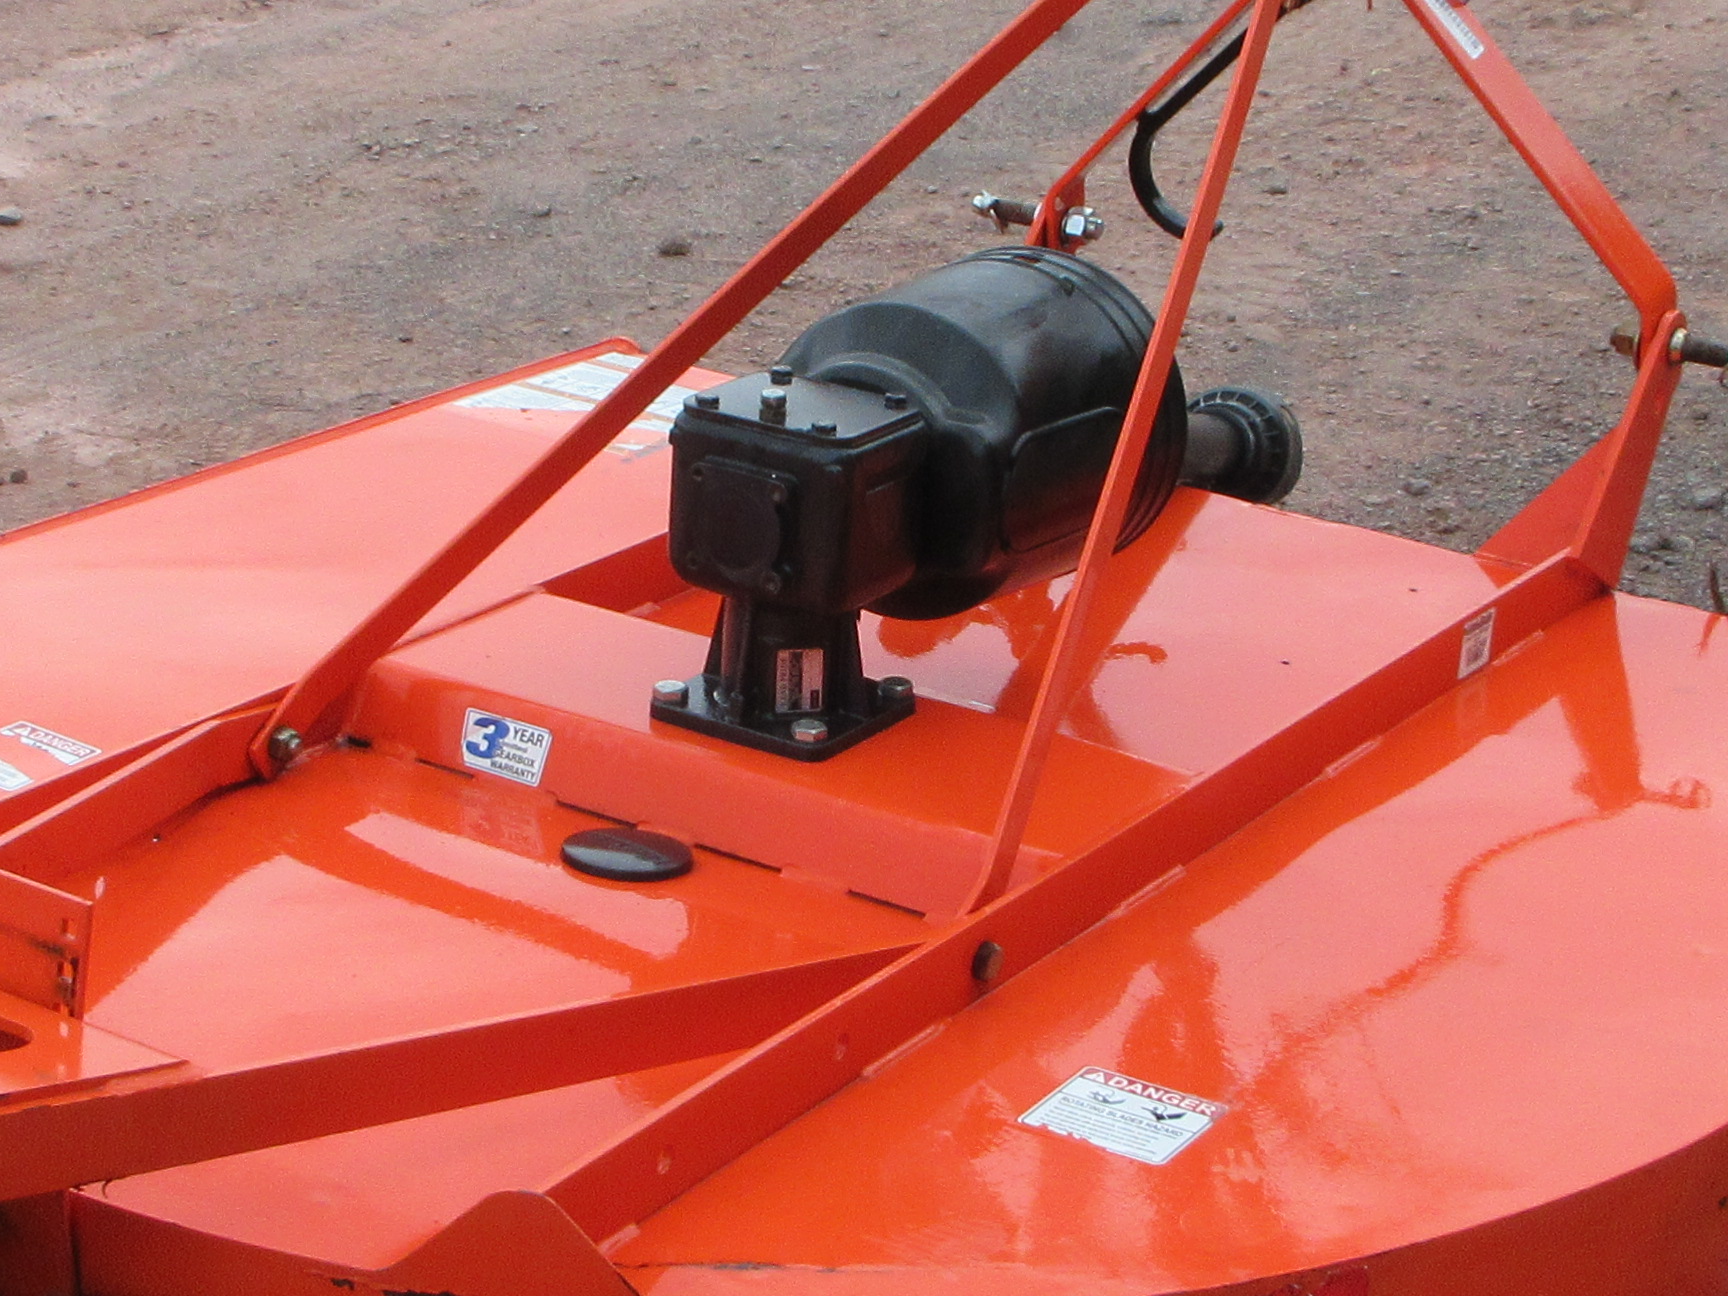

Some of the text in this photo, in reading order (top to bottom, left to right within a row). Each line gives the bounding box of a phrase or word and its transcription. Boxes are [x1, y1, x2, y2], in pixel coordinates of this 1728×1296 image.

[29, 729, 92, 758] DANGER
[466, 717, 545, 759] 3 YEAR
[490, 760, 536, 781] WARRANTY
[494, 747, 536, 769] GEARBOX
[1107, 1075, 1218, 1117] DANGER
